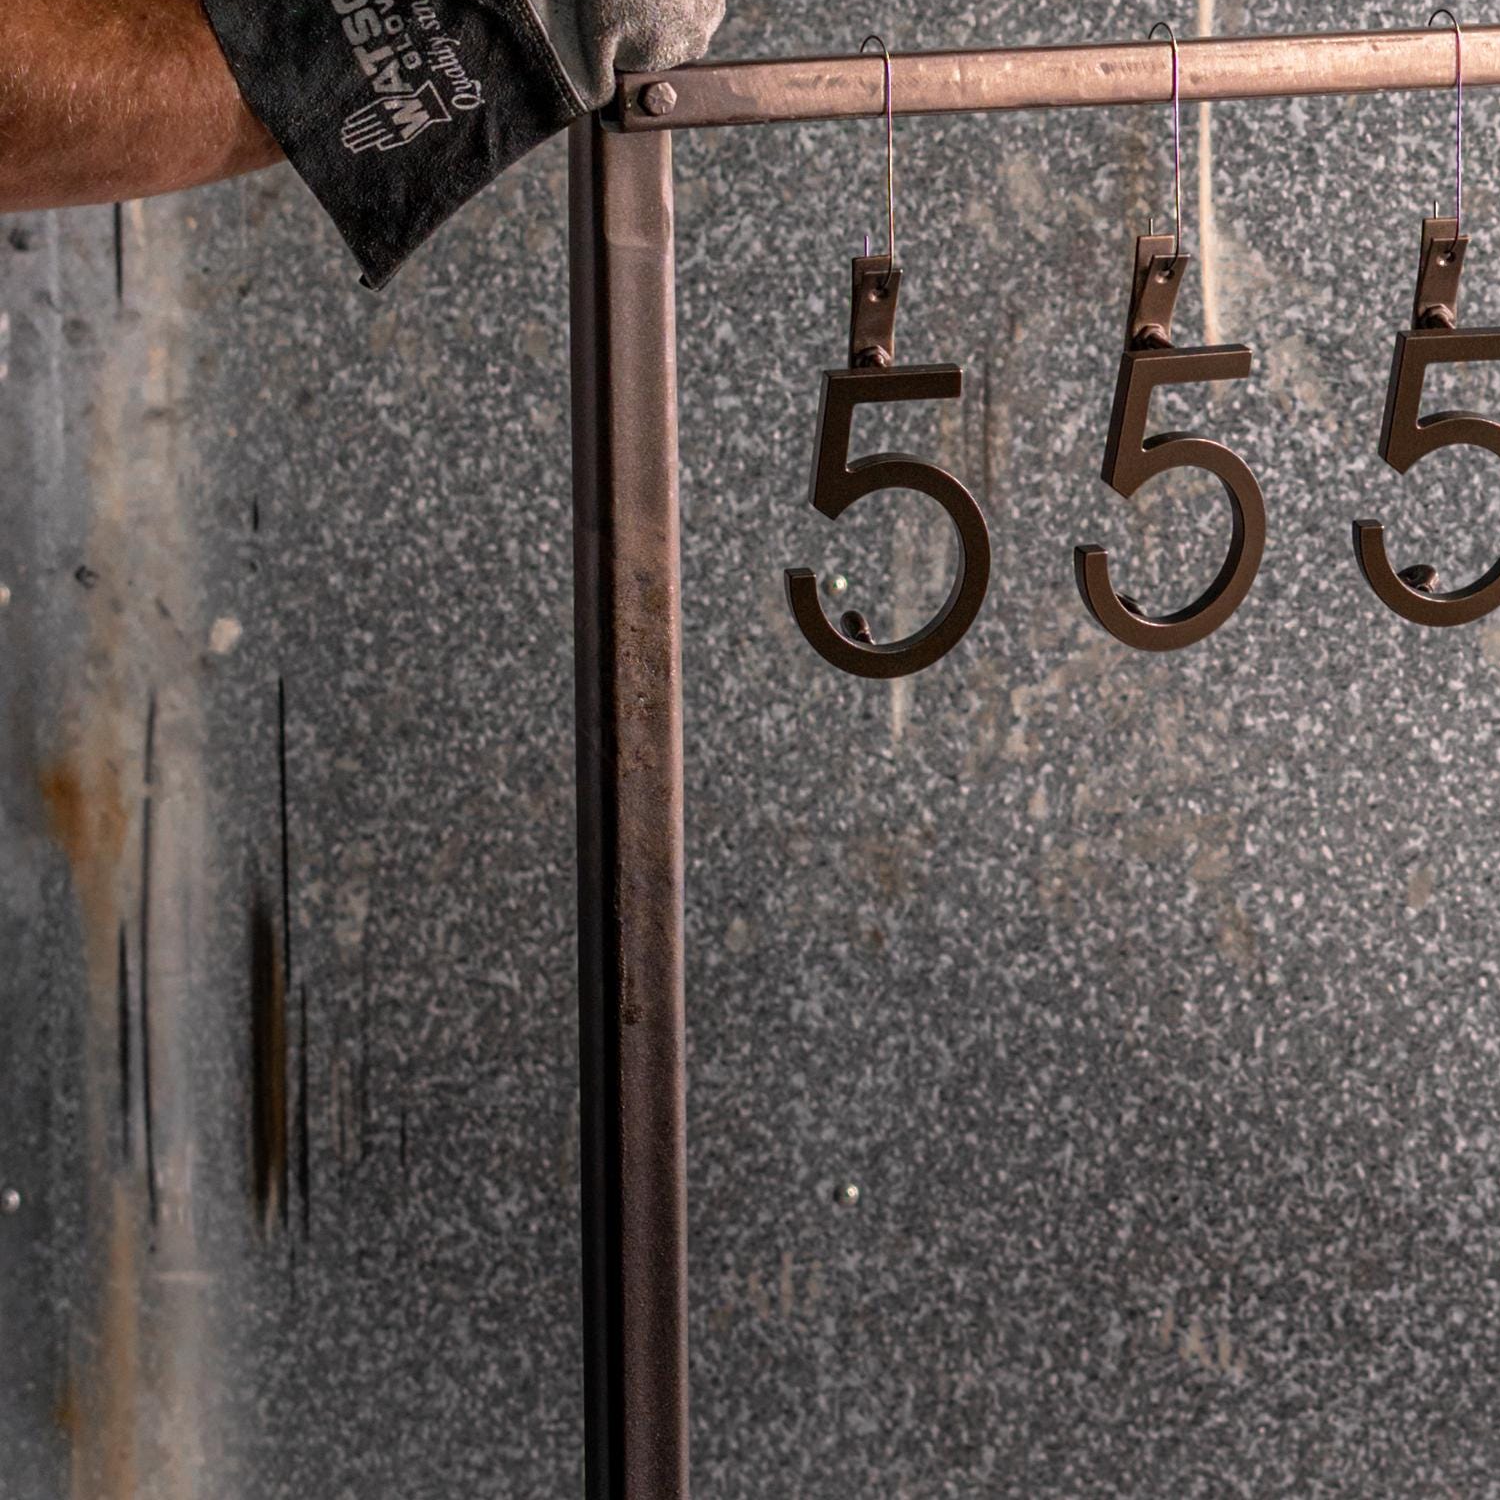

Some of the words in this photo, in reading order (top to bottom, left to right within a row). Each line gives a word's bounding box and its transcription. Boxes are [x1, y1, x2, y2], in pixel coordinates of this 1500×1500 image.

[427, 35, 486, 110] Quality
[784, 363, 991, 679] 5
[1074, 344, 1266, 652] 5
